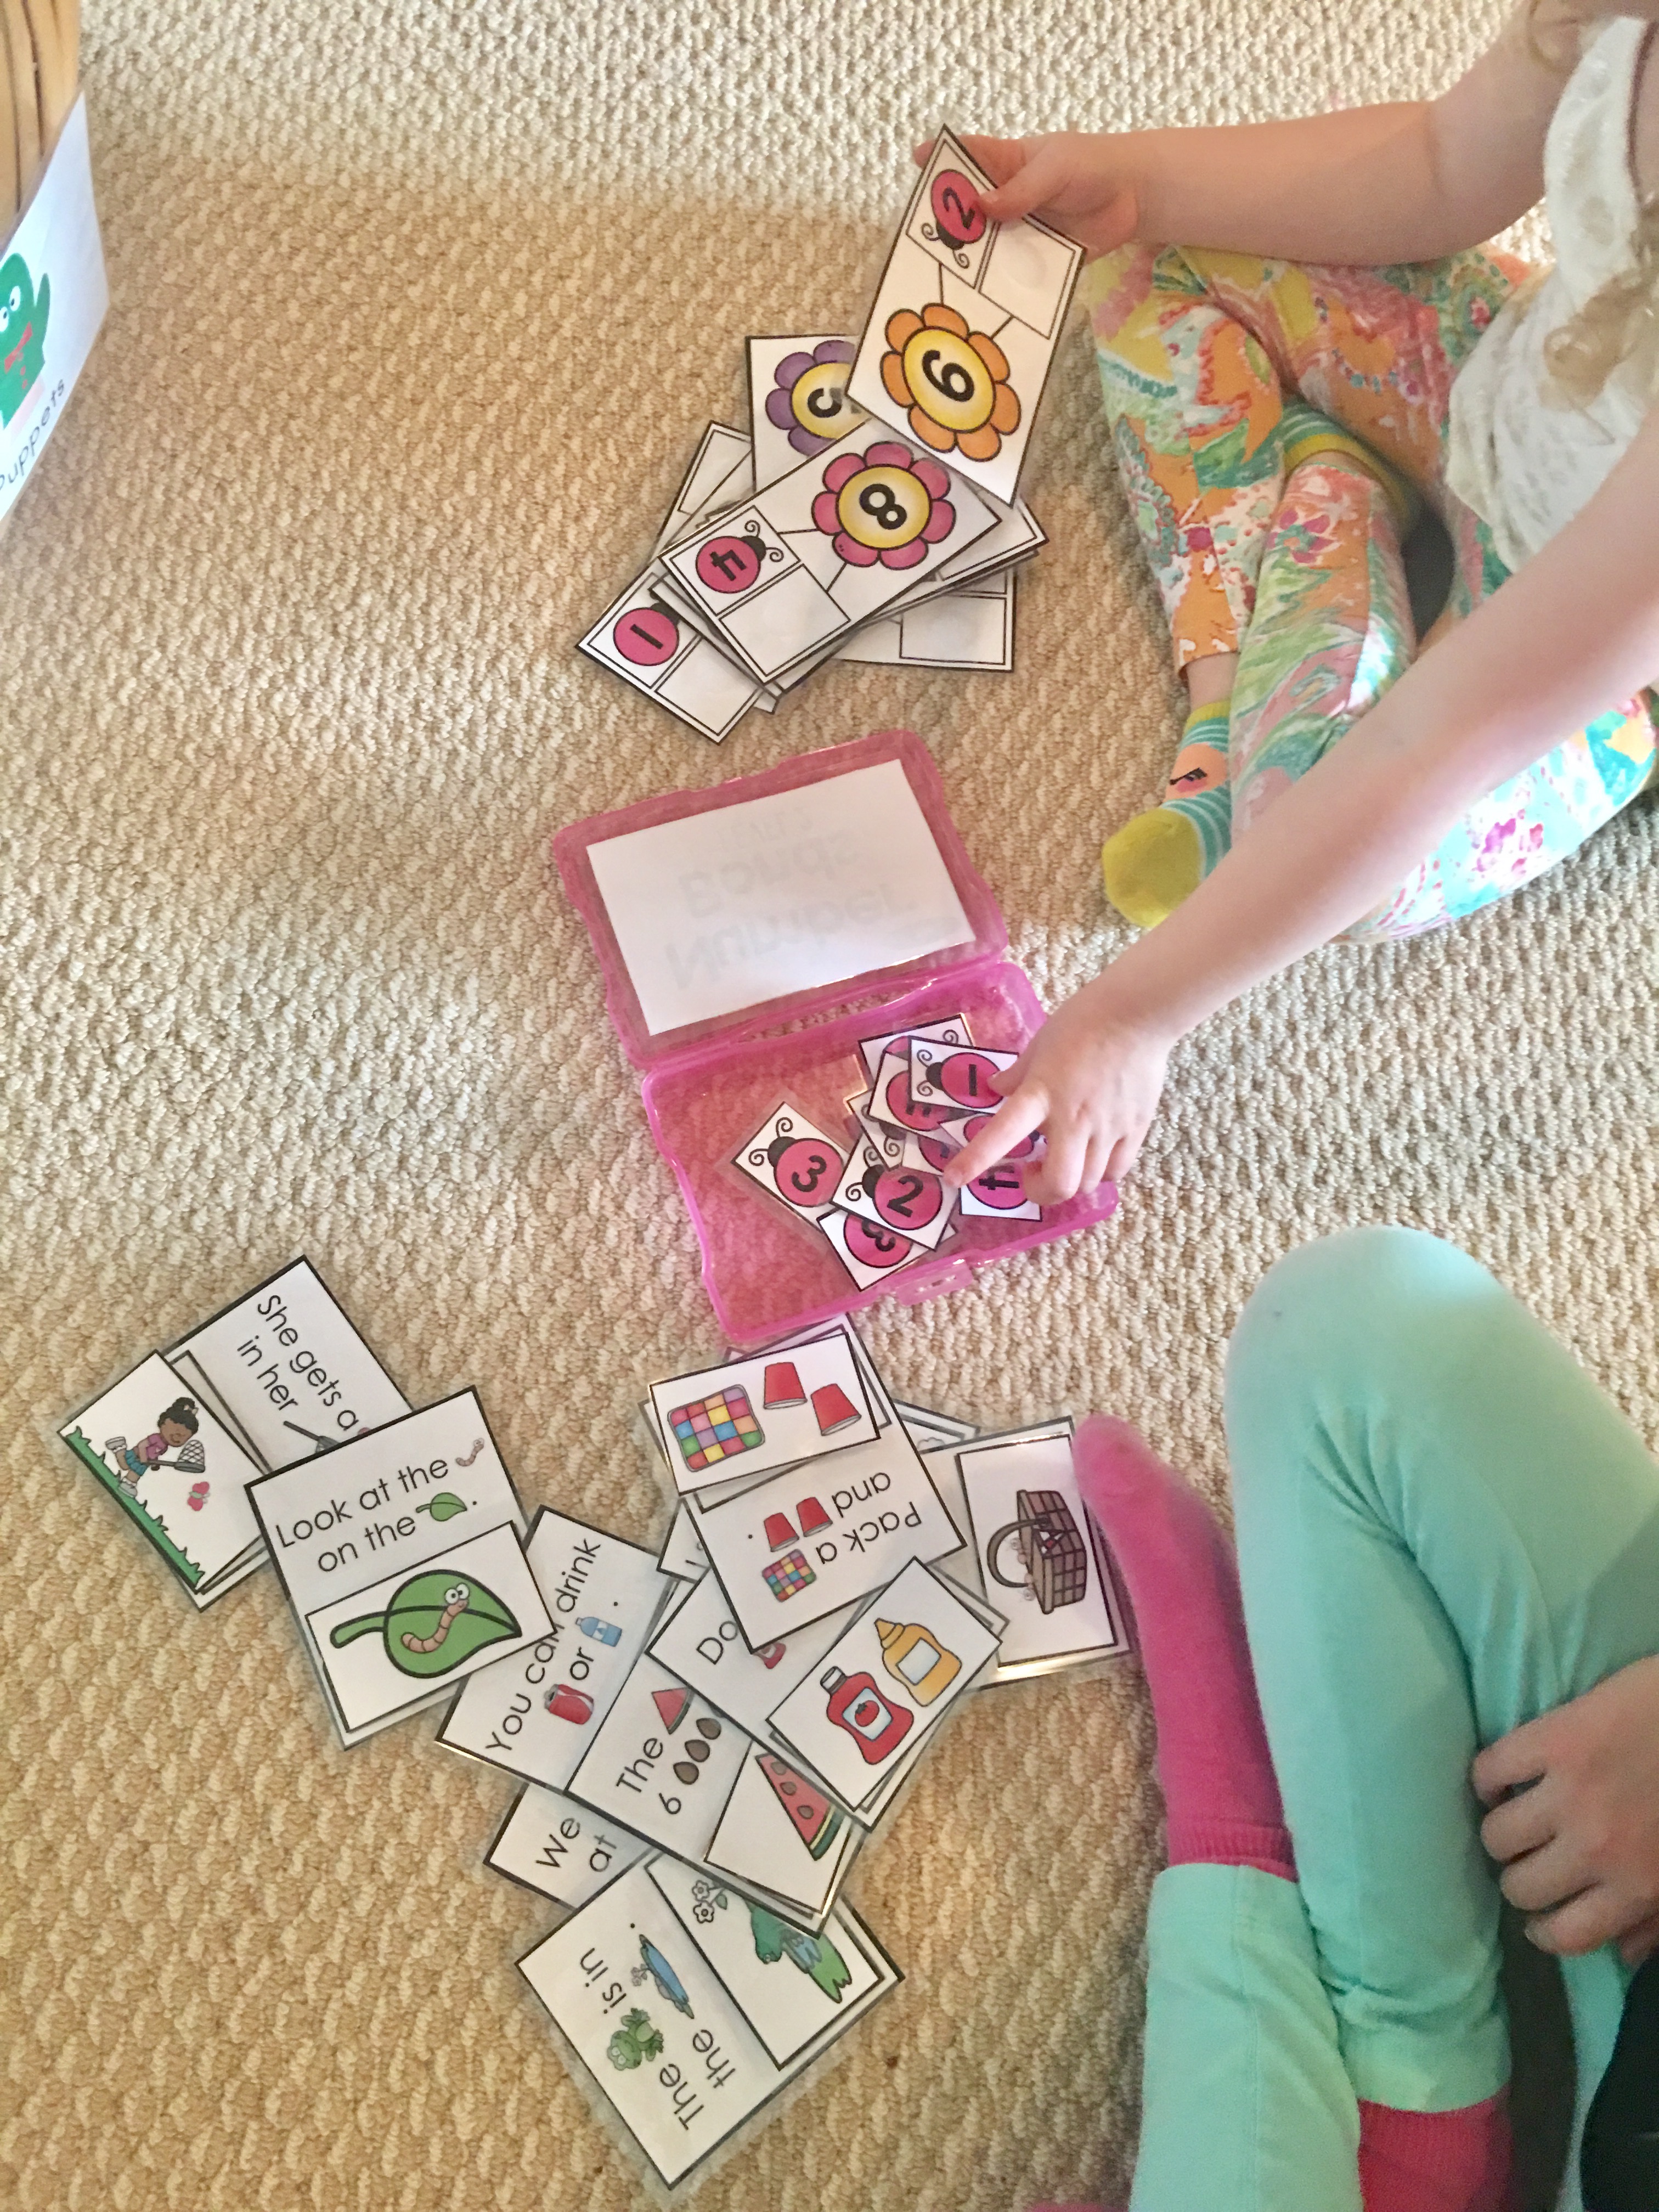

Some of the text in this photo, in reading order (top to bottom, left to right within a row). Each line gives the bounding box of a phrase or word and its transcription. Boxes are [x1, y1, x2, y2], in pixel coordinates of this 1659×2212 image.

[943, 187, 975, 230] 2
[922, 349, 974, 402] 6
[859, 484, 907, 530] 8
[710, 549, 747, 582] 4
[630, 624, 663, 650] 1
[968, 1063, 977, 1097] 1
[792, 1155, 827, 1194] 3
[887, 1175, 924, 1217] 2
[236, 1335, 298, 1411] in her
[258, 1295, 359, 1431] She gets a
[275, 1459, 448, 1548] Look at the
[832, 1472, 890, 1518] and
[318, 1516, 415, 1571] on the
[816, 1502, 922, 1564] Pack a
[486, 1693, 531, 1751] You
[555, 1538, 601, 1613] drink
[570, 1646, 594, 1680] or
[696, 1621, 738, 1664] Do
[616, 1737, 663, 1793] The
[659, 1792, 681, 1815] 6
[535, 1817, 580, 1868] We
[589, 1835, 617, 1872] at
[580, 1948, 704, 2130] The is in
[693, 2029, 736, 2089] the
